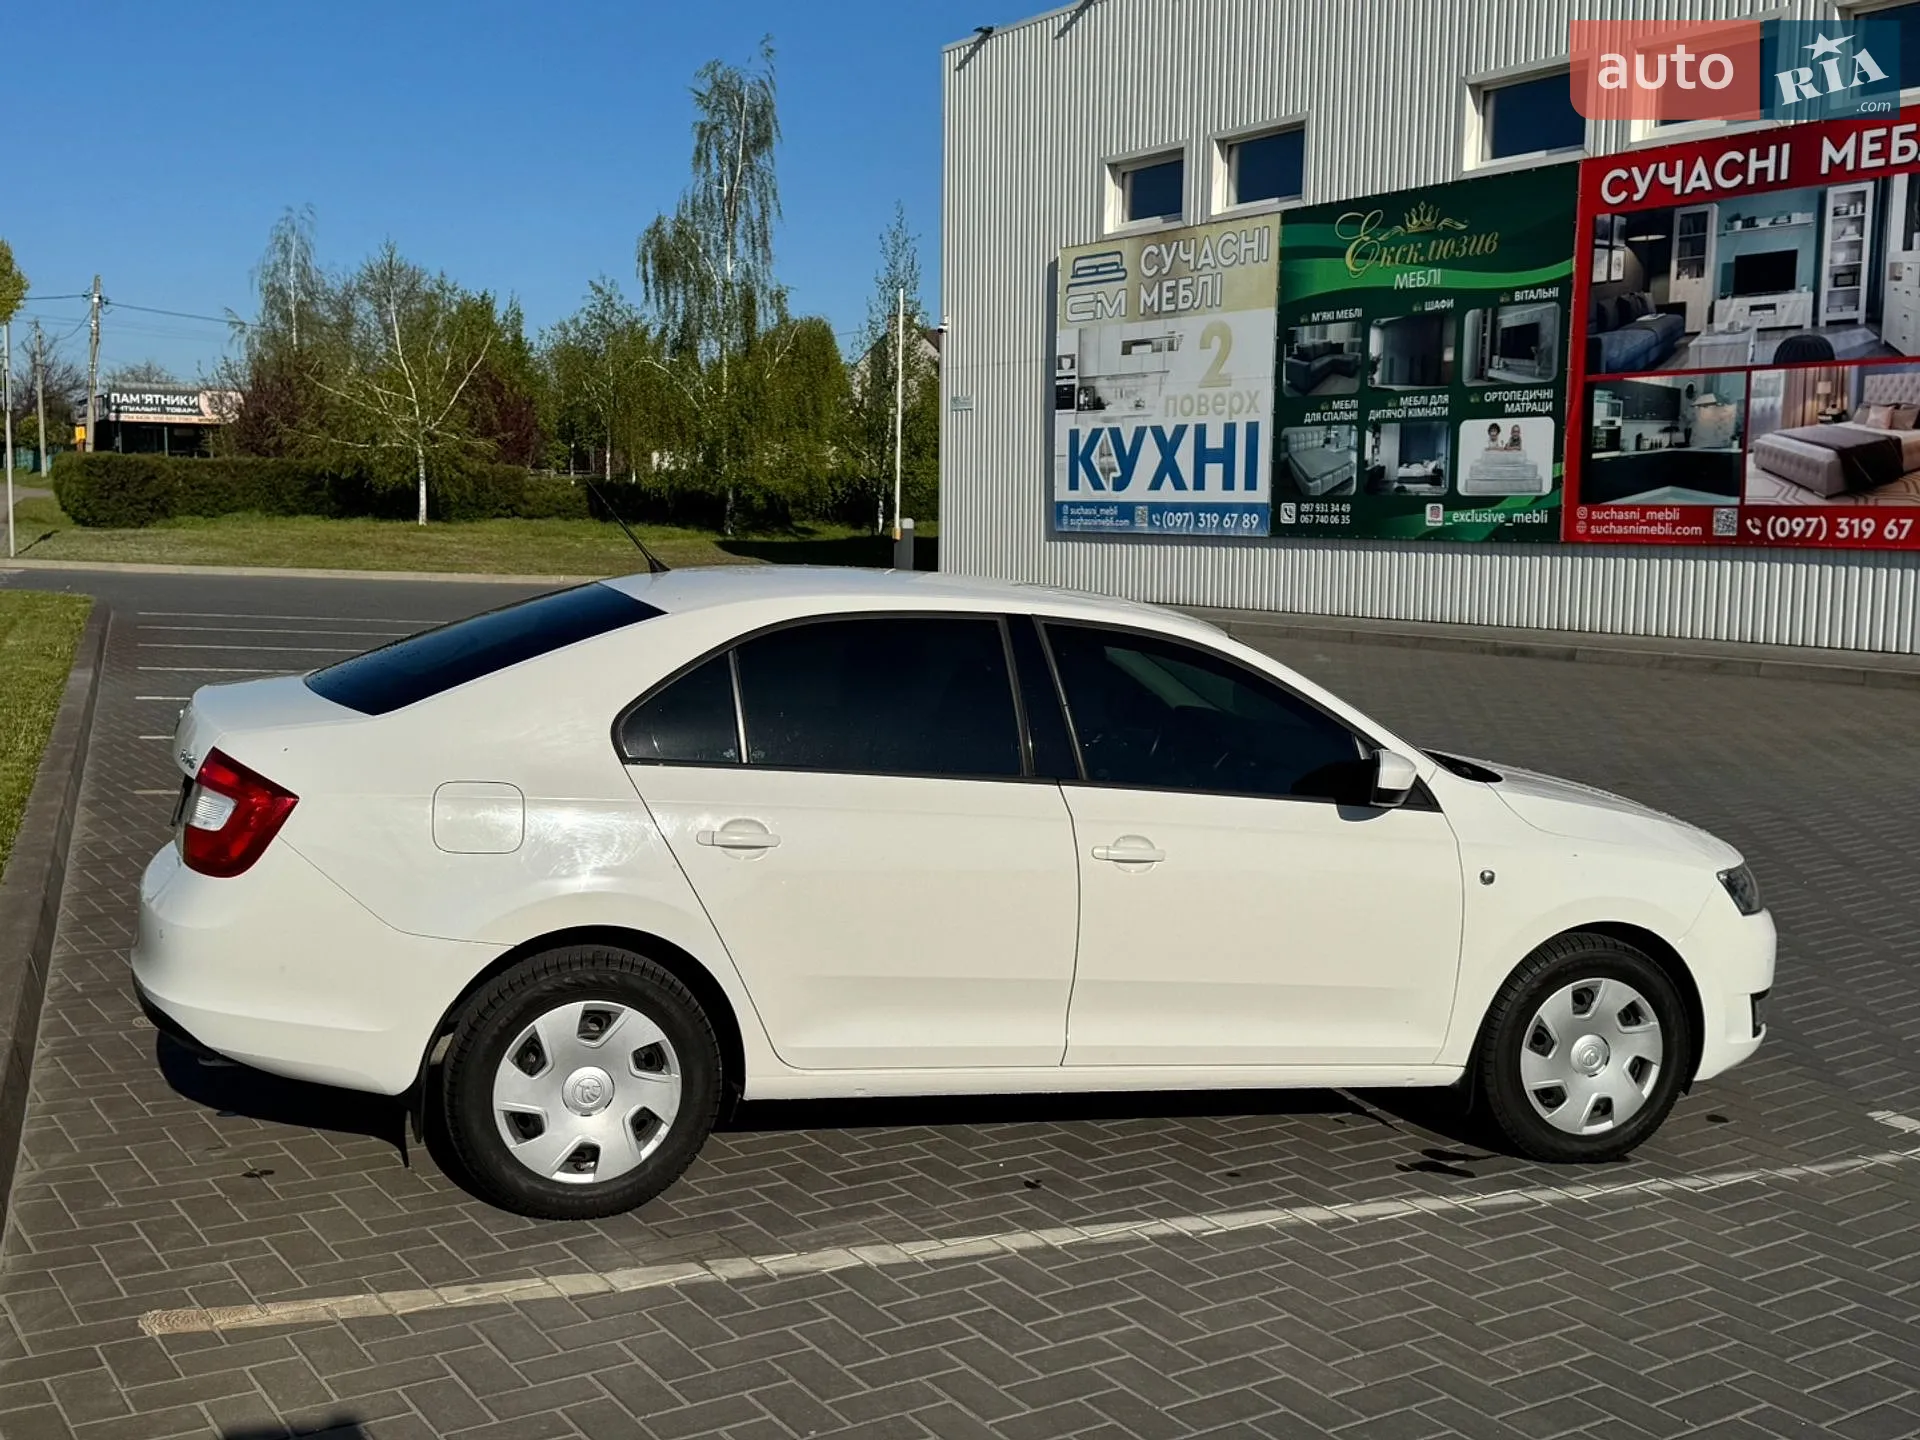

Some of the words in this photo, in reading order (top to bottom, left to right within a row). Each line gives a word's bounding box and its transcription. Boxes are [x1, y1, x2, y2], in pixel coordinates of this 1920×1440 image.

[1601, 142, 1790, 205] СУЧАСНІ
[1820, 123, 1920, 175] МЕБ
[1335, 209, 1500, 279] Ексклюзив
[1139, 226, 1271, 278] СУЧАСНІ
[1394, 268, 1441, 290] МЕБЛІ
[1139, 272, 1223, 316] МЕБЛІ
[1514, 287, 1559, 302] ВІТАЛЬНІ
[1424, 299, 1454, 311] ШАФИ
[1335, 308, 1363, 320] МЕБЛІ
[1199, 320, 1233, 388] 2
[110, 393, 199, 406] ПАМ'ЯТНИКИ
[1400, 396, 1428, 406] МЕБЛІ
[1429, 394, 1449, 406] ДЛЯ
[1484, 389, 1553, 403] ОРТОПЕДИЧНІ
[1164, 389, 1261, 419] поверх
[1332, 400, 1359, 410] МЕБЛІ
[1504, 401, 1553, 413] МАТРАЦИ
[1304, 412, 1321, 424] ДЛЯ
[1322, 411, 1358, 422] СПАЛЬНІ
[1368, 408, 1407, 421] ДИТЯЧОЇ
[1408, 406, 1449, 418] КІМНАТИ
[1068, 421, 1260, 492] КУХНІ
[1162, 511, 1194, 530] (097)
[1198, 512, 1218, 529] 319
[1222, 513, 1238, 529] 67
[1242, 513, 1259, 529] 89
[1591, 507, 1680, 522] suchasni_mebli
[1590, 522, 1702, 536] suchasnimebli.com
[1766, 516, 1827, 541] (097)
[1835, 517, 1875, 539] 319
[1883, 518, 1914, 540] 67
